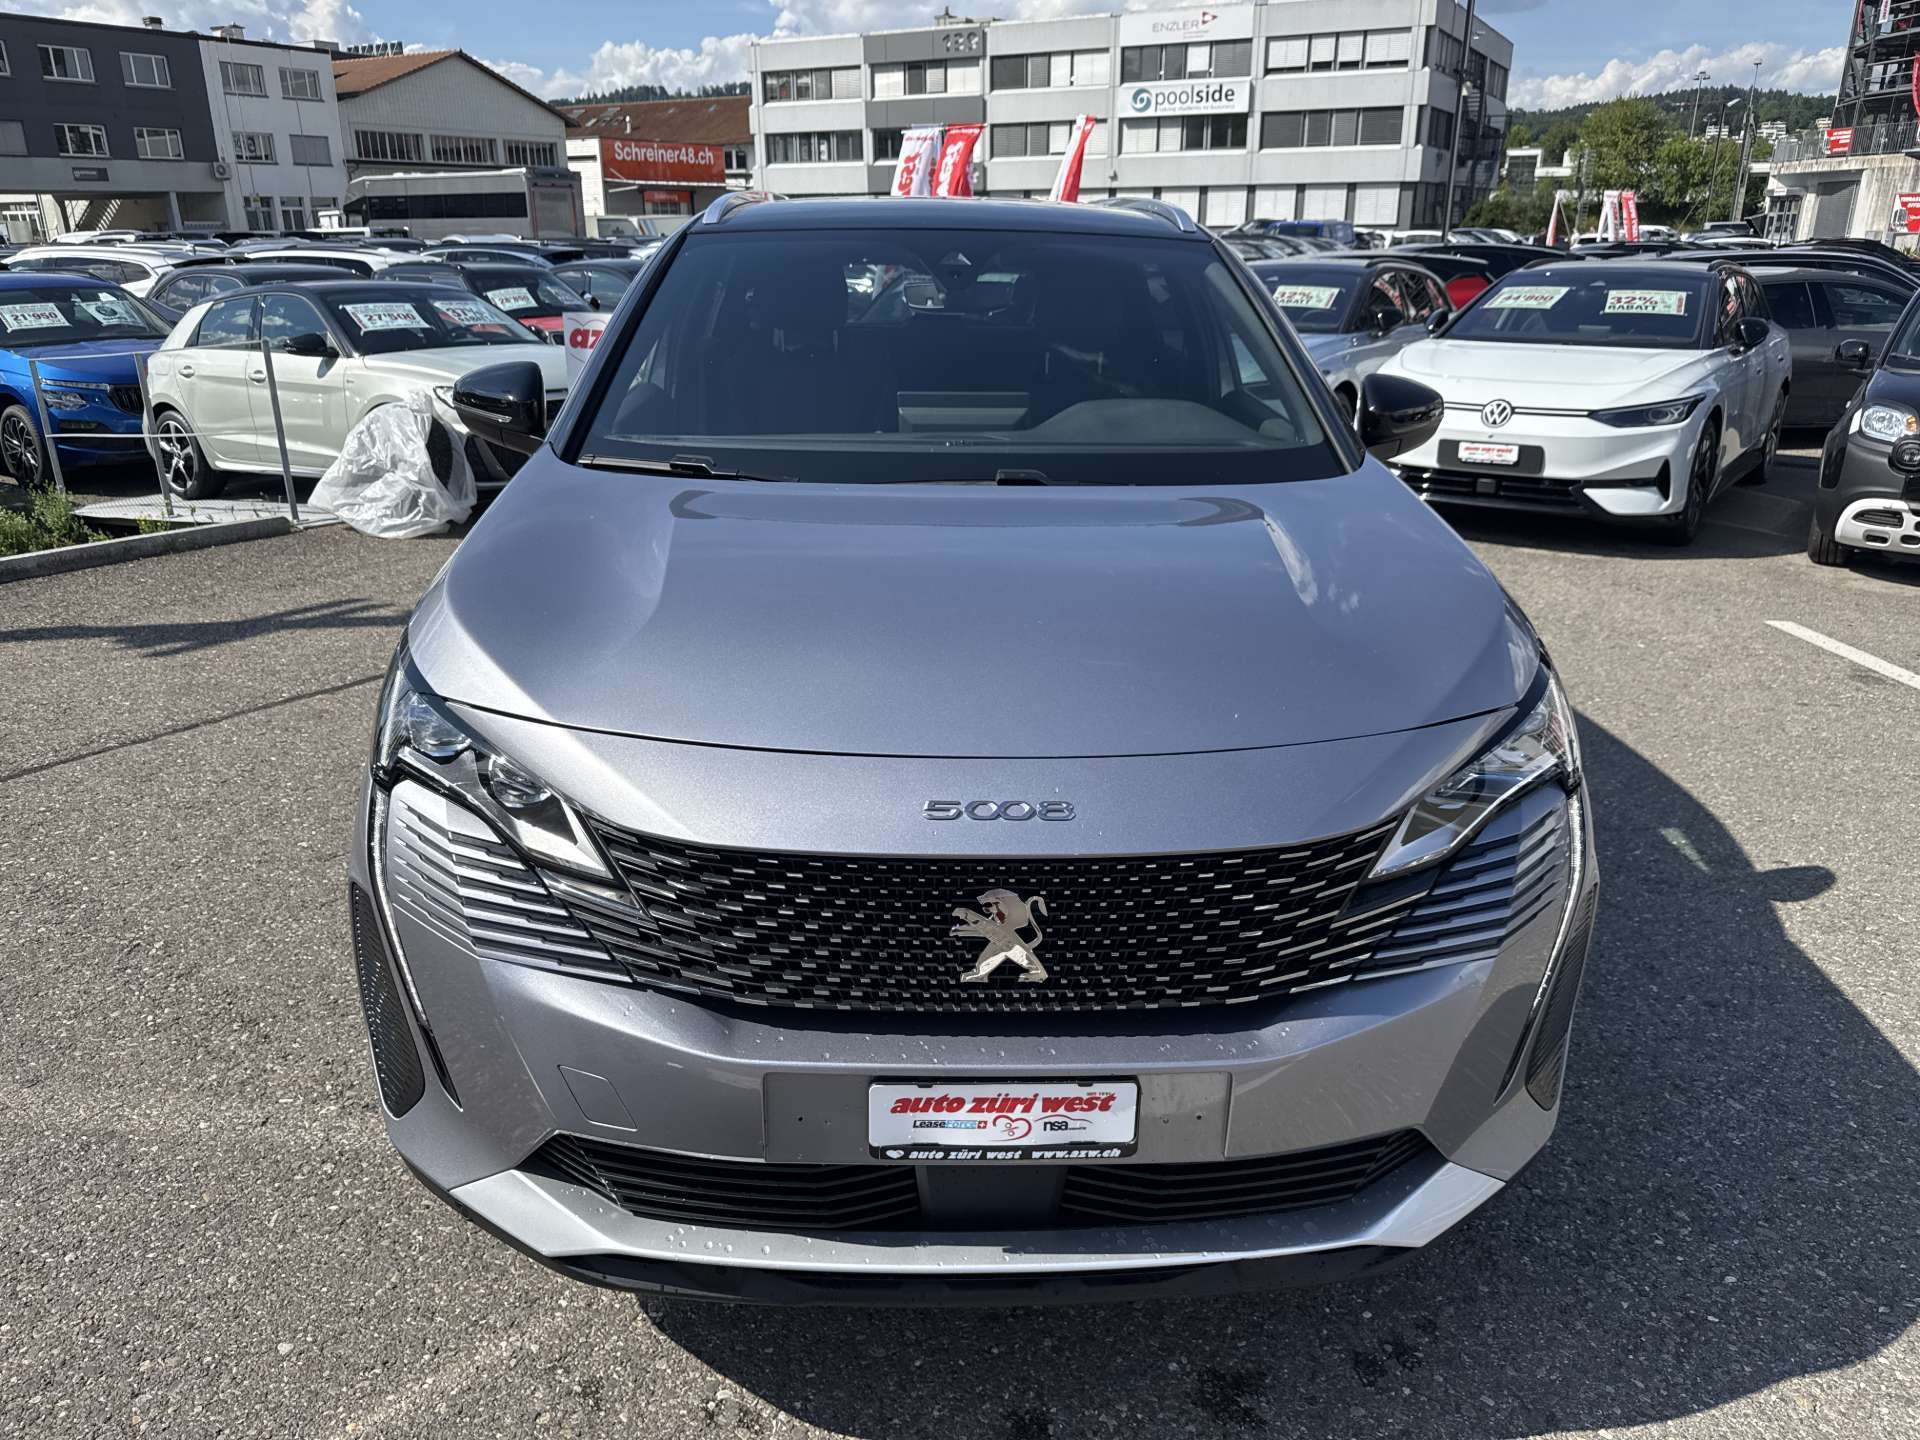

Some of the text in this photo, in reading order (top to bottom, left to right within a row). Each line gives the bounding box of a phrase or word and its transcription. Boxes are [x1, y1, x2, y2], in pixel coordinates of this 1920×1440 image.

[1152, 20, 1199, 33] ENZLER
[1155, 84, 1235, 112] poolside
[614, 142, 714, 165] Schreiner48.ch
[1610, 296, 1658, 304] 32%
[922, 800, 1077, 822] 5008
[890, 1093, 1117, 1114] auto züri west
[1043, 1120, 1069, 1131] nsa
[908, 1148, 1121, 1160] auto züri west www.azw.ch
